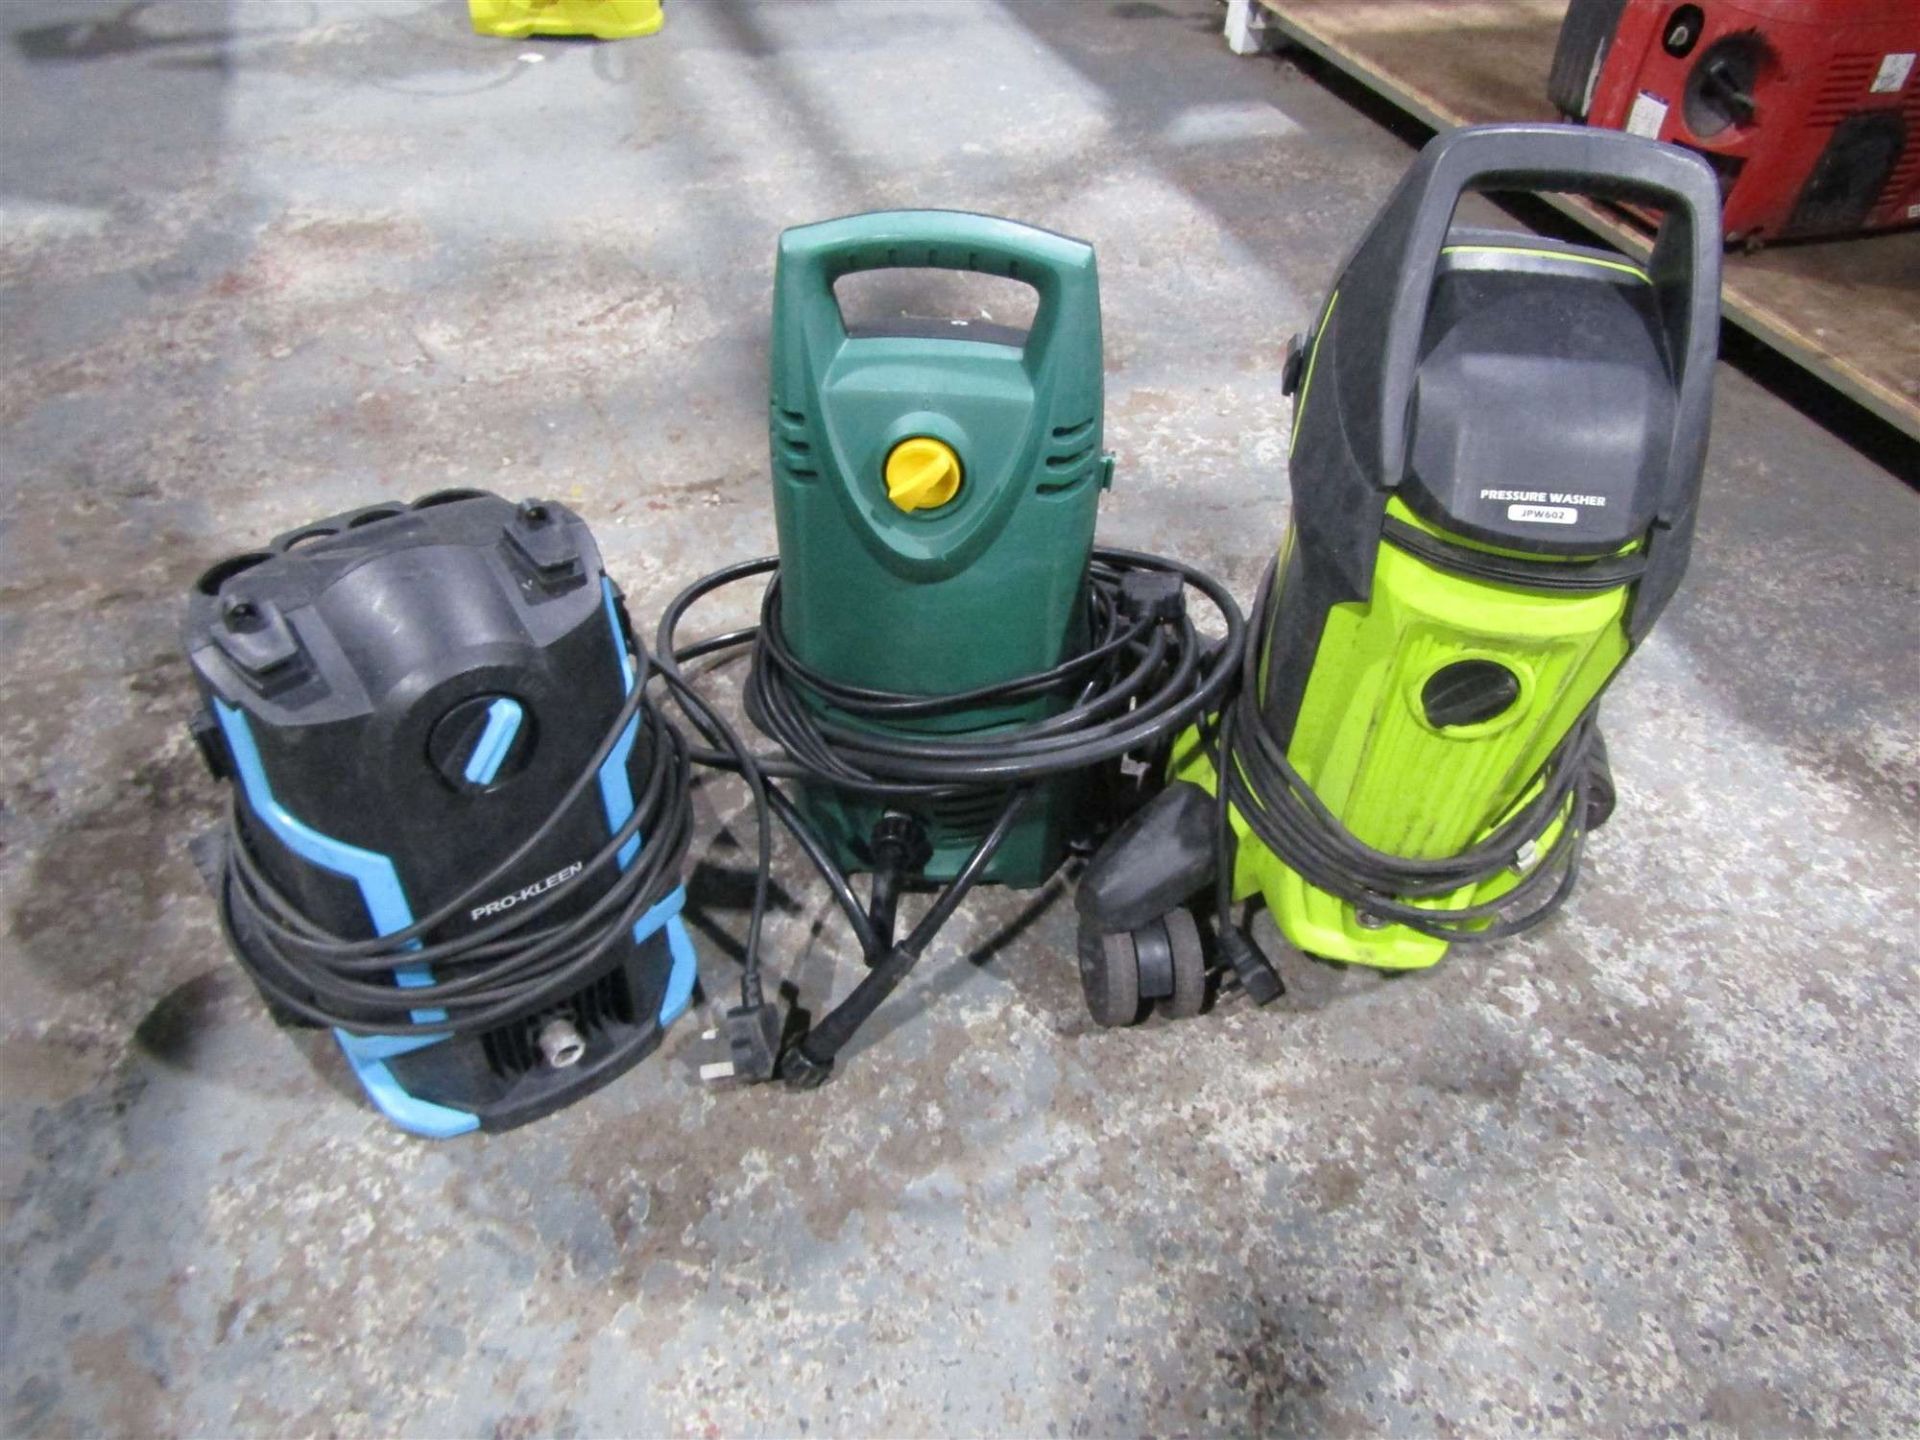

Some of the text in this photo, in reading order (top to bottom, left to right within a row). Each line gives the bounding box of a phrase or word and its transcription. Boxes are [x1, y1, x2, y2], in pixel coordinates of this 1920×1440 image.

[1480, 489, 1606, 506] PRESSURE WASHER
[1521, 510, 1565, 520] JPW602
[471, 861, 582, 921] PRO-KLEEN
